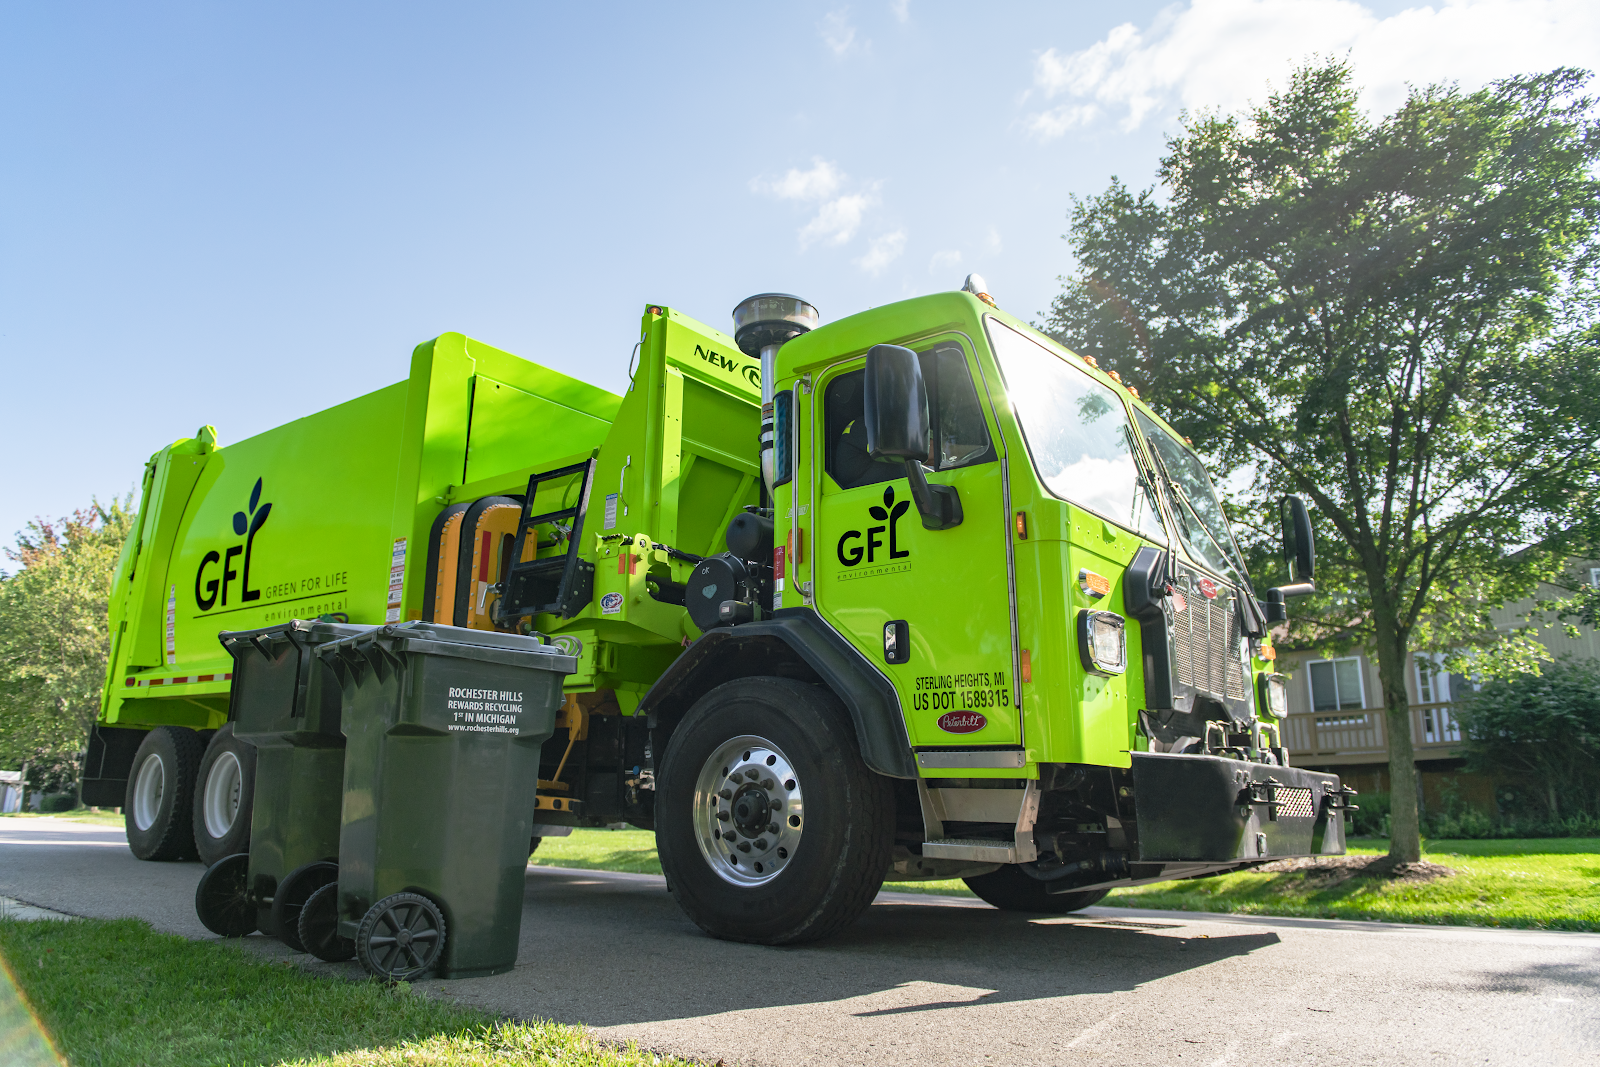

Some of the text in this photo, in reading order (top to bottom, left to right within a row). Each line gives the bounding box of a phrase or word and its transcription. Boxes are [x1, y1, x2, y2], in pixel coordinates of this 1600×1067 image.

[694, 344, 739, 373] NEW
[837, 500, 910, 567] GFL
[195, 503, 272, 611] GFL
[837, 563, 911, 580] environmental
[265, 571, 348, 599] GREEN FOR LIFE
[265, 598, 348, 621] environmental
[915, 671, 1005, 690] STERLING HEIGHTS, MI
[448, 687, 523, 702] ROCHESTER HILLS
[913, 689, 1009, 710] US DOT 1589315
[448, 700, 523, 713] REWARDS RECYCLING
[453, 712, 516, 724] 1ST IN MICHIGAN
[942, 714, 982, 728] Peterbilt
[448, 724, 520, 735] www.rochesterhills.org
